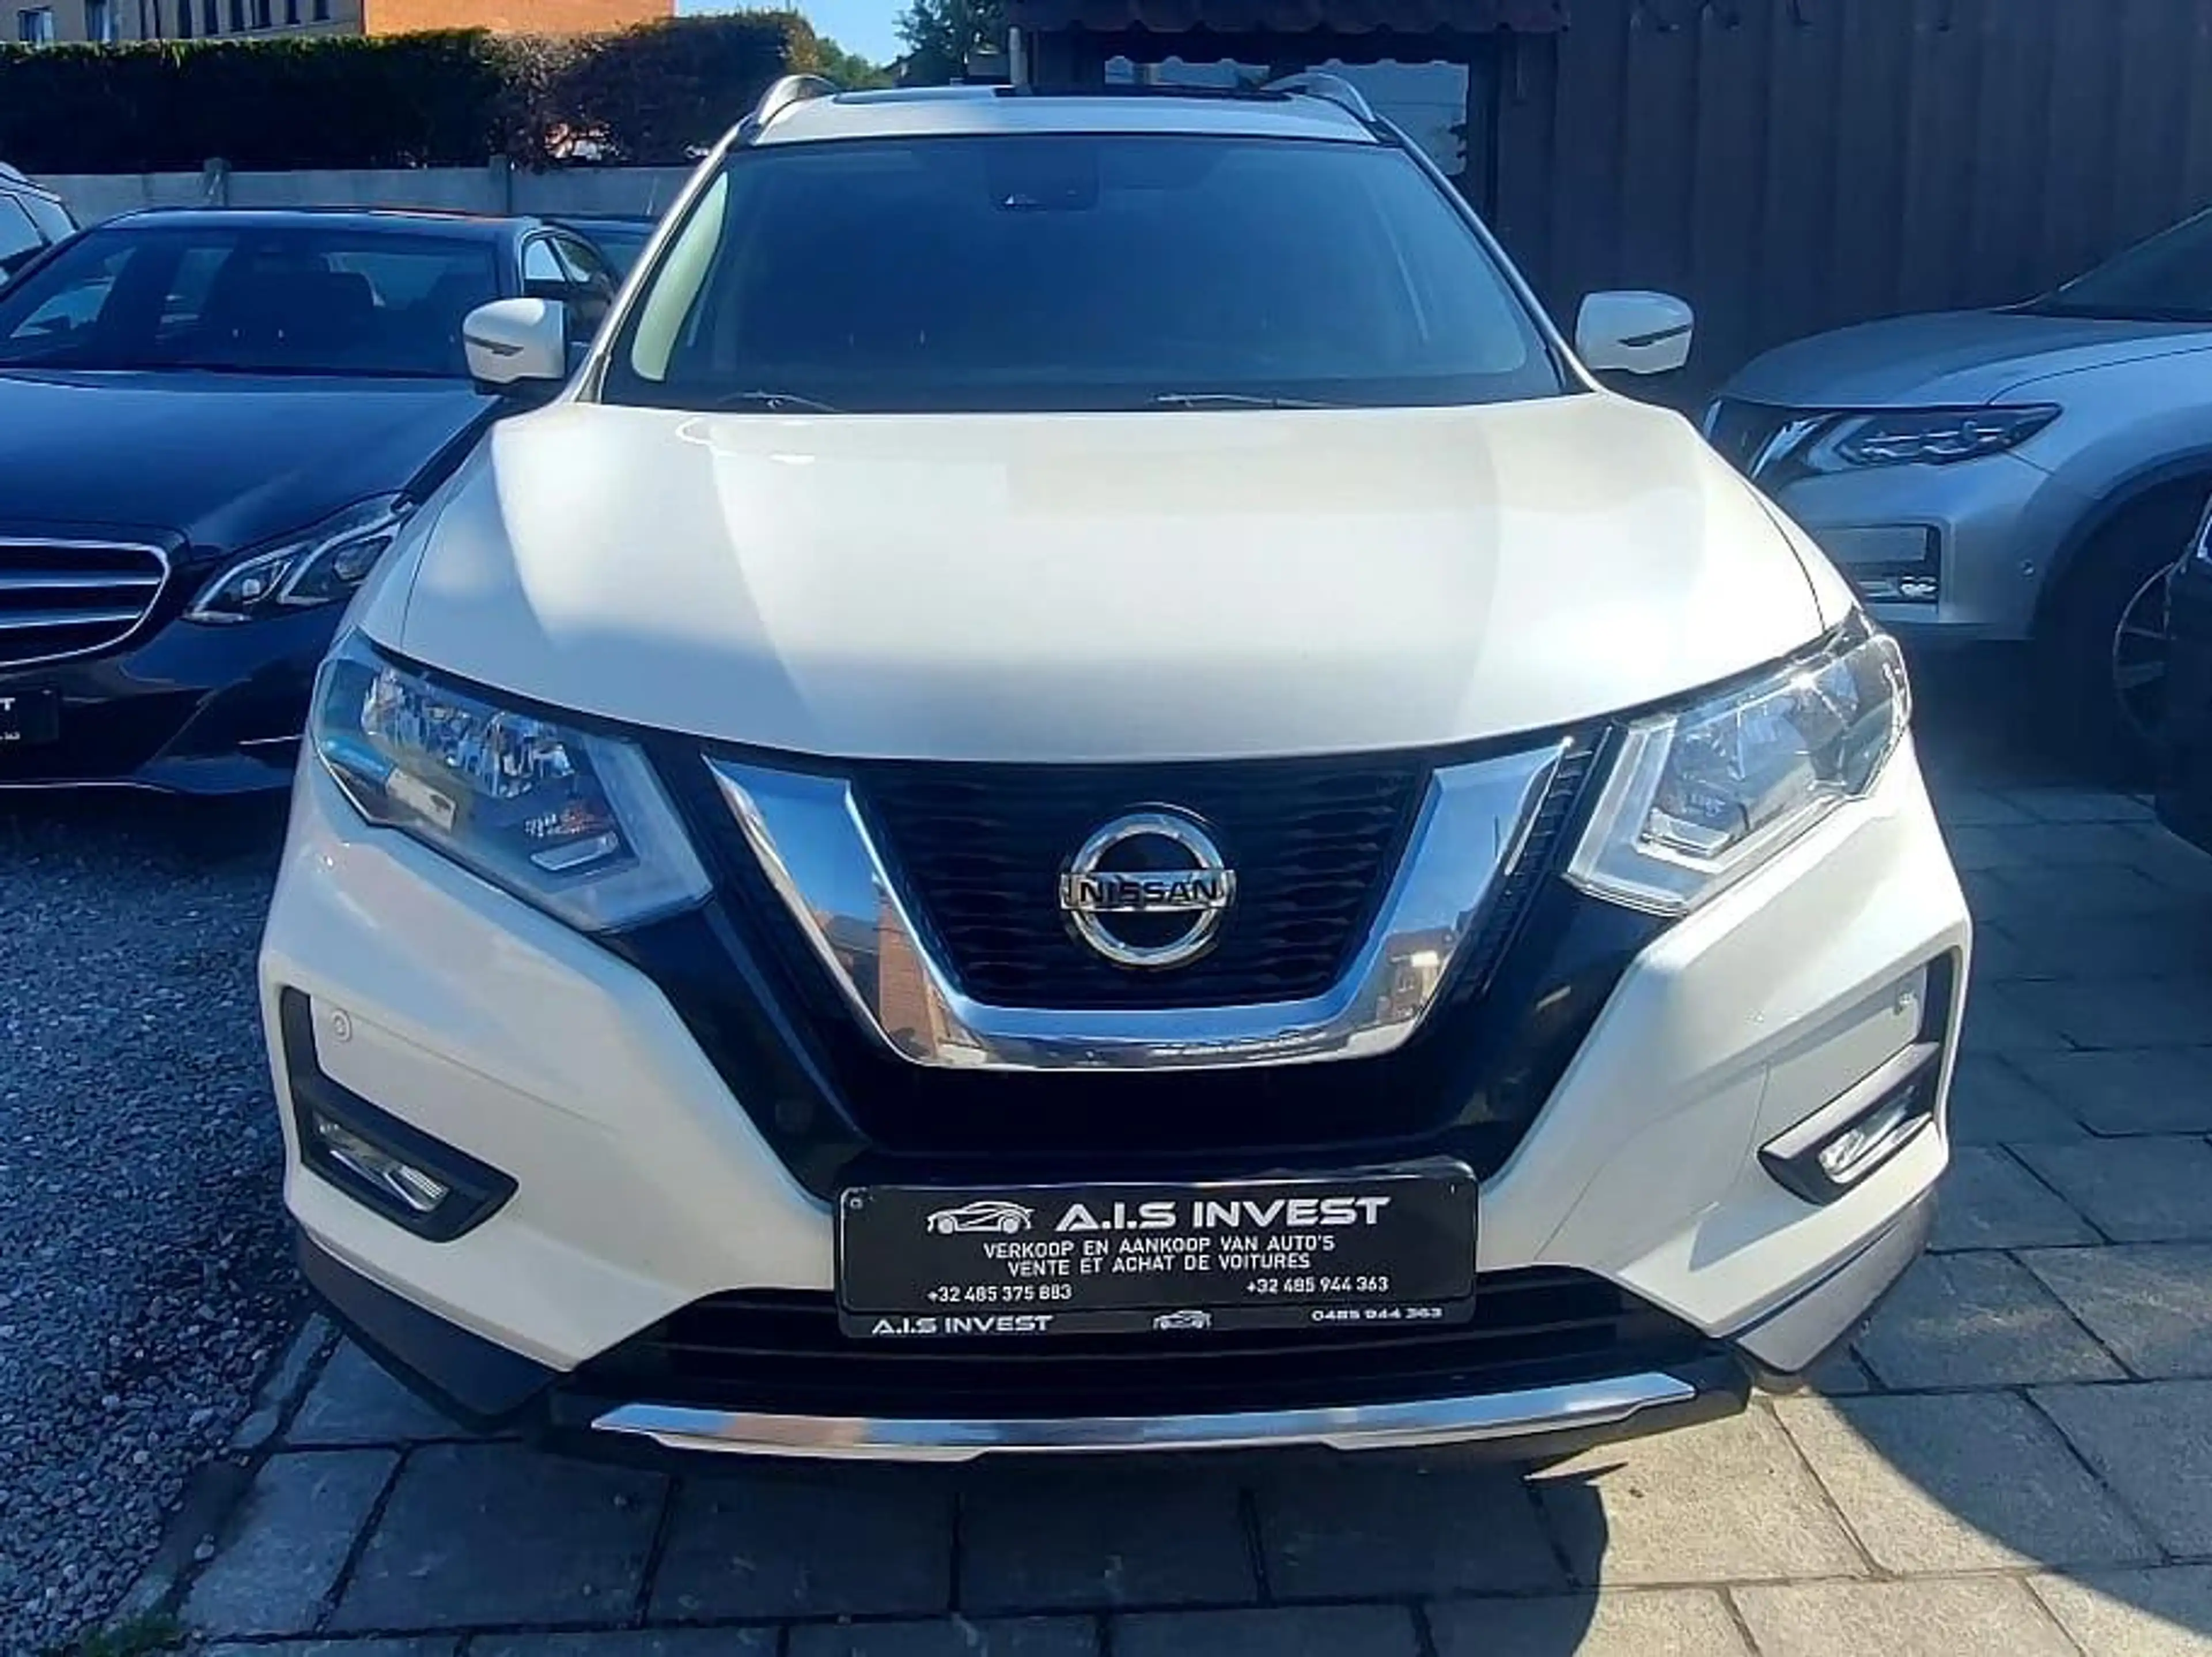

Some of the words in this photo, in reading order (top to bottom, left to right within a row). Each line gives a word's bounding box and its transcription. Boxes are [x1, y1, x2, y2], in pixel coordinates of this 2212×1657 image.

[1080, 879, 1217, 903] NISSAN
[1055, 1201, 1176, 1231] A.I.S
[1193, 1197, 1391, 1227] INVEST
[983, 1240, 1074, 1258] VERKOOP
[1083, 1239, 1108, 1255] EN
[1119, 1238, 1210, 1254] AANKOOP
[1221, 1236, 1258, 1252] VAN
[1267, 1235, 1335, 1251] AUTO'S
[1008, 1259, 1071, 1277] VENTE
[1080, 1257, 1103, 1274] ET
[1112, 1255, 1175, 1272] ACHAT
[1184, 1255, 1210, 1270] DE
[1218, 1253, 1311, 1270] VOITURES
[927, 1287, 961, 1302] +32
[1002, 1285, 1035, 1301] 375
[1247, 1278, 1279, 1294] +32
[1283, 1277, 1315, 1292] 485
[1320, 1277, 1352, 1292] 944
[1356, 1276, 1389, 1292] 363
[872, 1317, 937, 1334] A.I.S
[945, 1315, 1054, 1333] INVEST
